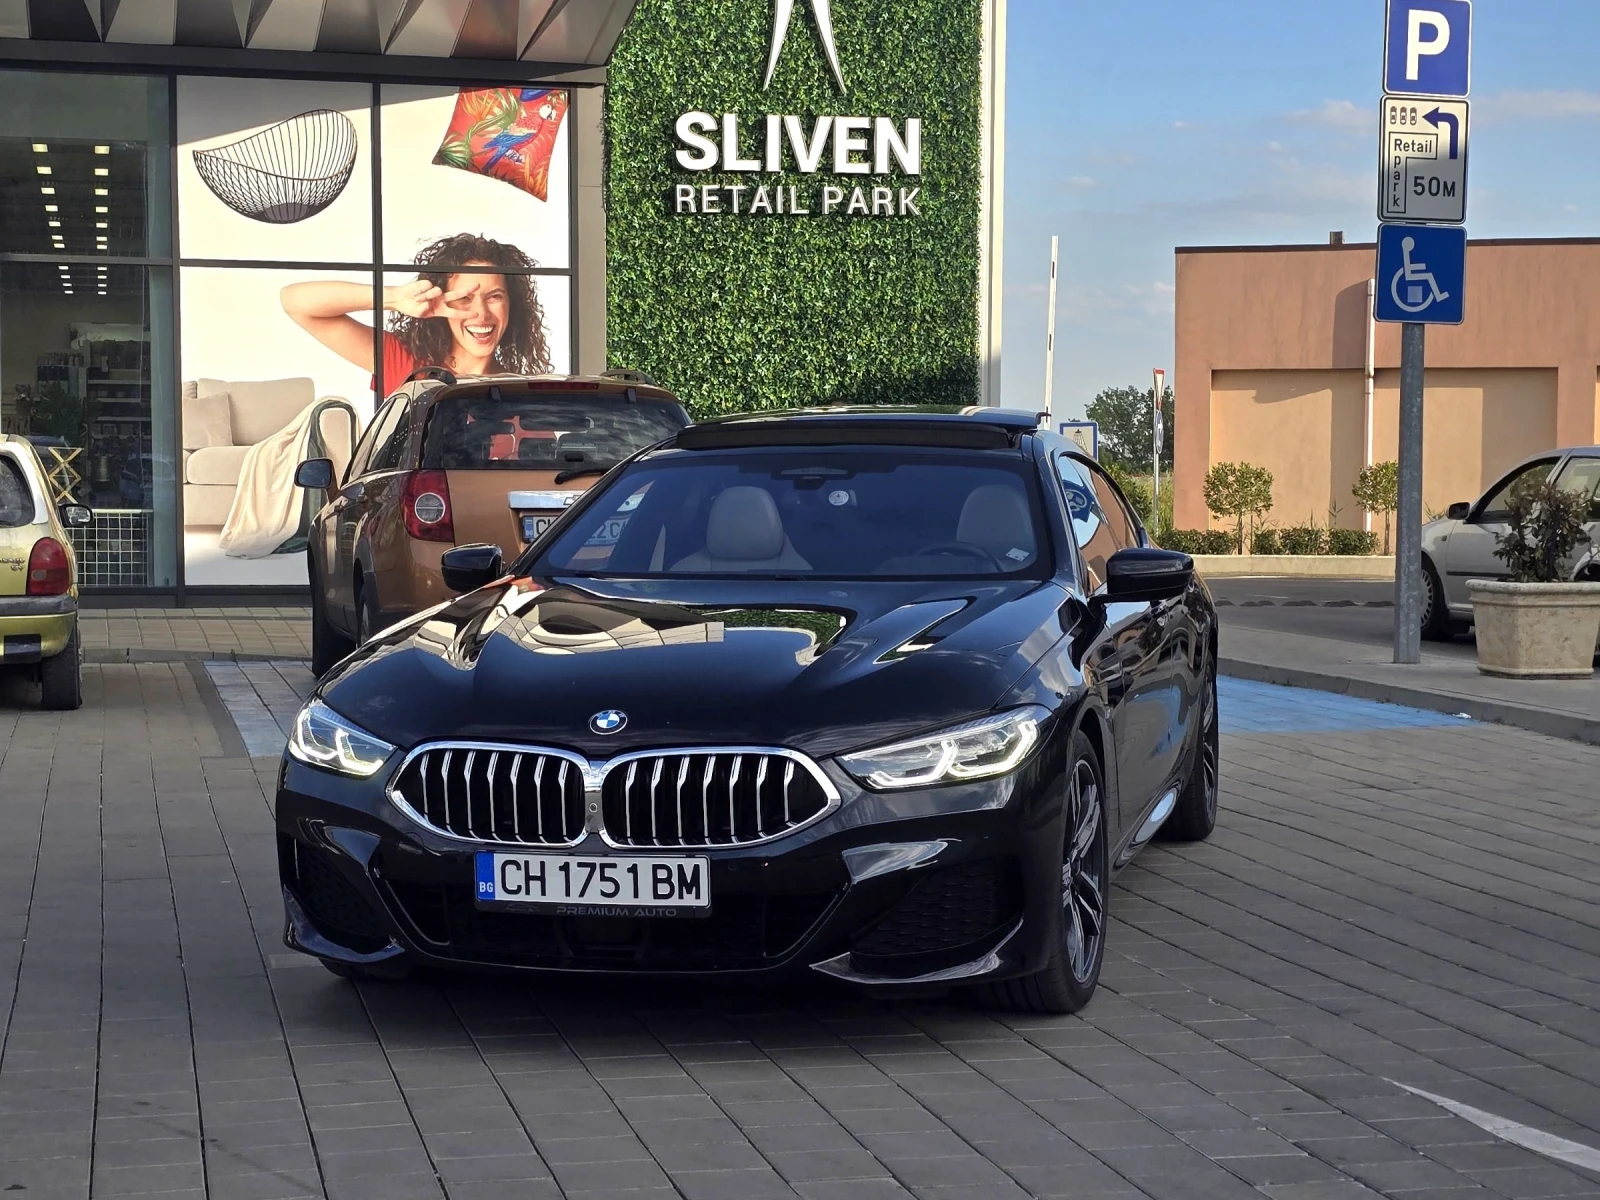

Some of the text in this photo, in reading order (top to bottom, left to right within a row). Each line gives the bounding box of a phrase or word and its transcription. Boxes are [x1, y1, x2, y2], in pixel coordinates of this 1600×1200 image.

[1406, 9, 1450, 81] P
[675, 111, 922, 175] SLIVEN
[1394, 138, 1432, 153] Retail
[675, 184, 921, 216] RETAIL PARK
[479, 881, 494, 893] BG
[500, 859, 701, 900] CH 1751 BM
[556, 906, 677, 917] PREMIUM AUTO
